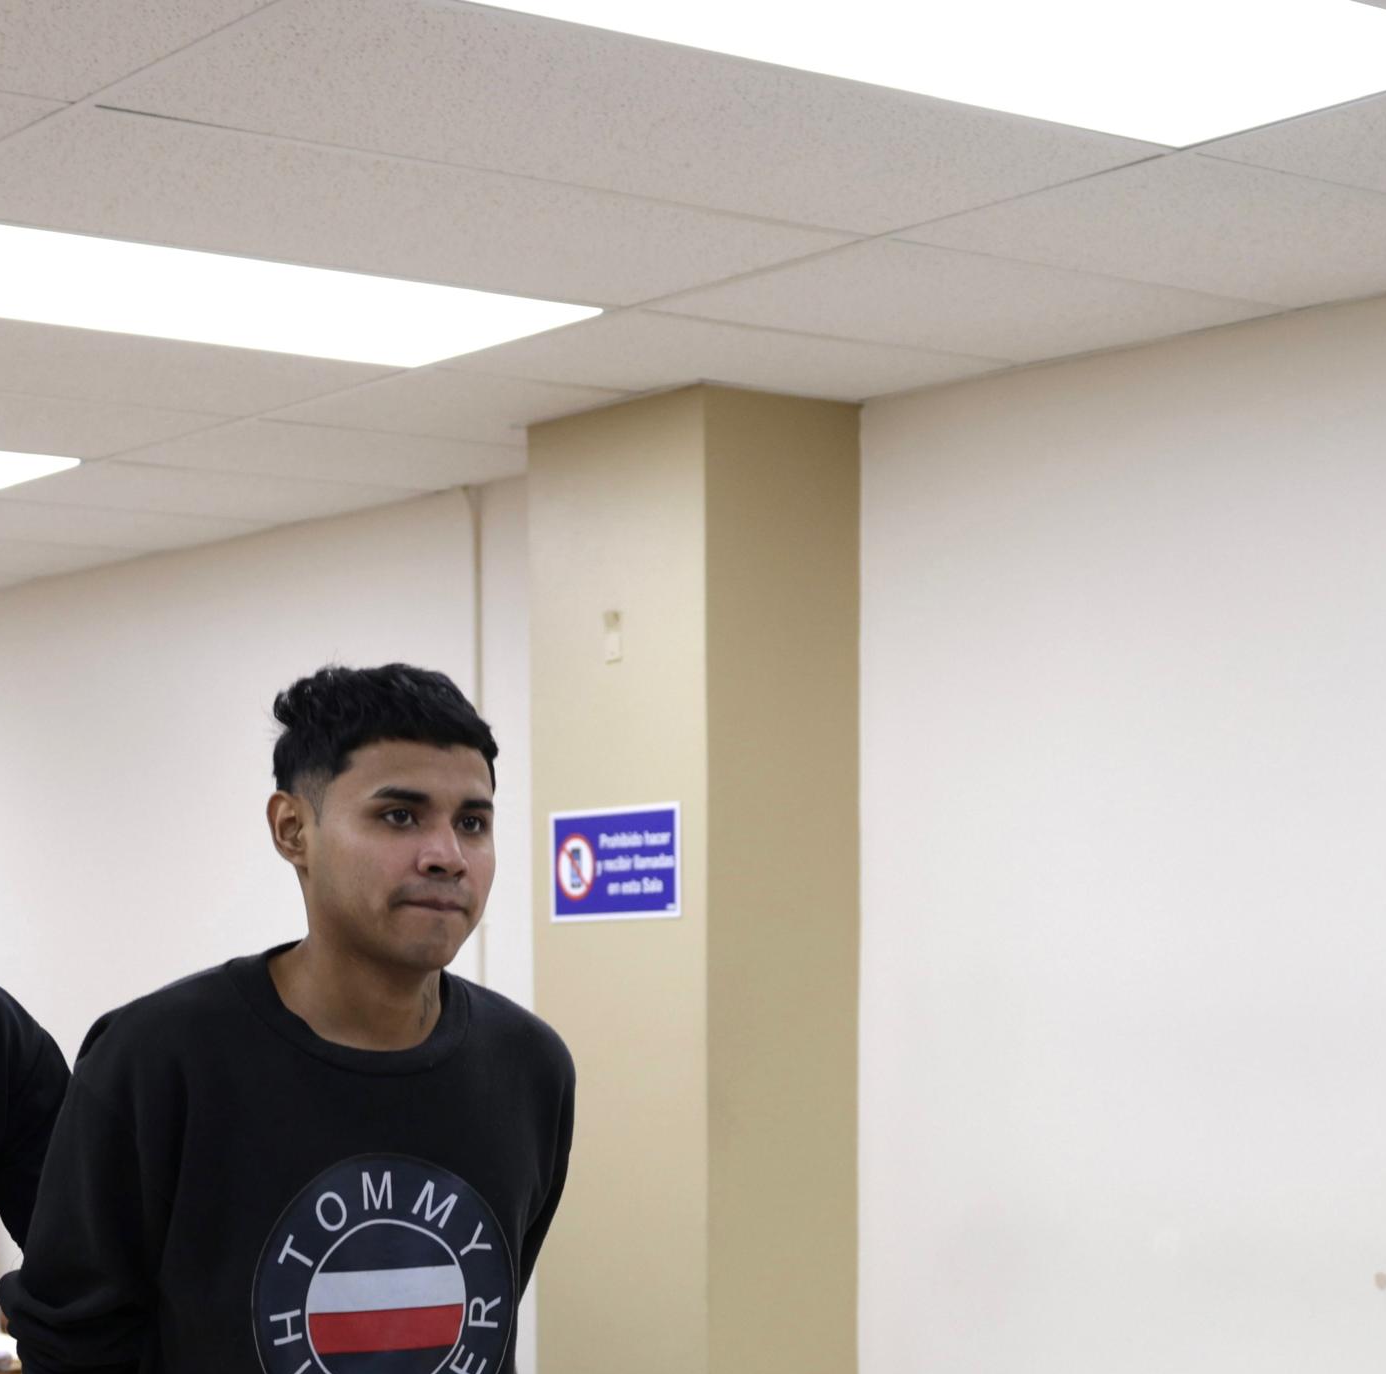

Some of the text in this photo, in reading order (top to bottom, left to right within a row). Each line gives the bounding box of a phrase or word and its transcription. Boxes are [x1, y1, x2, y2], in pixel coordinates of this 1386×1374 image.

[598, 830, 671, 849] Prohibido hacer
[596, 853, 675, 877] y recibir llamadas
[607, 876, 664, 896] en esta Sala
[277, 1171, 493, 1268] TOMMY
